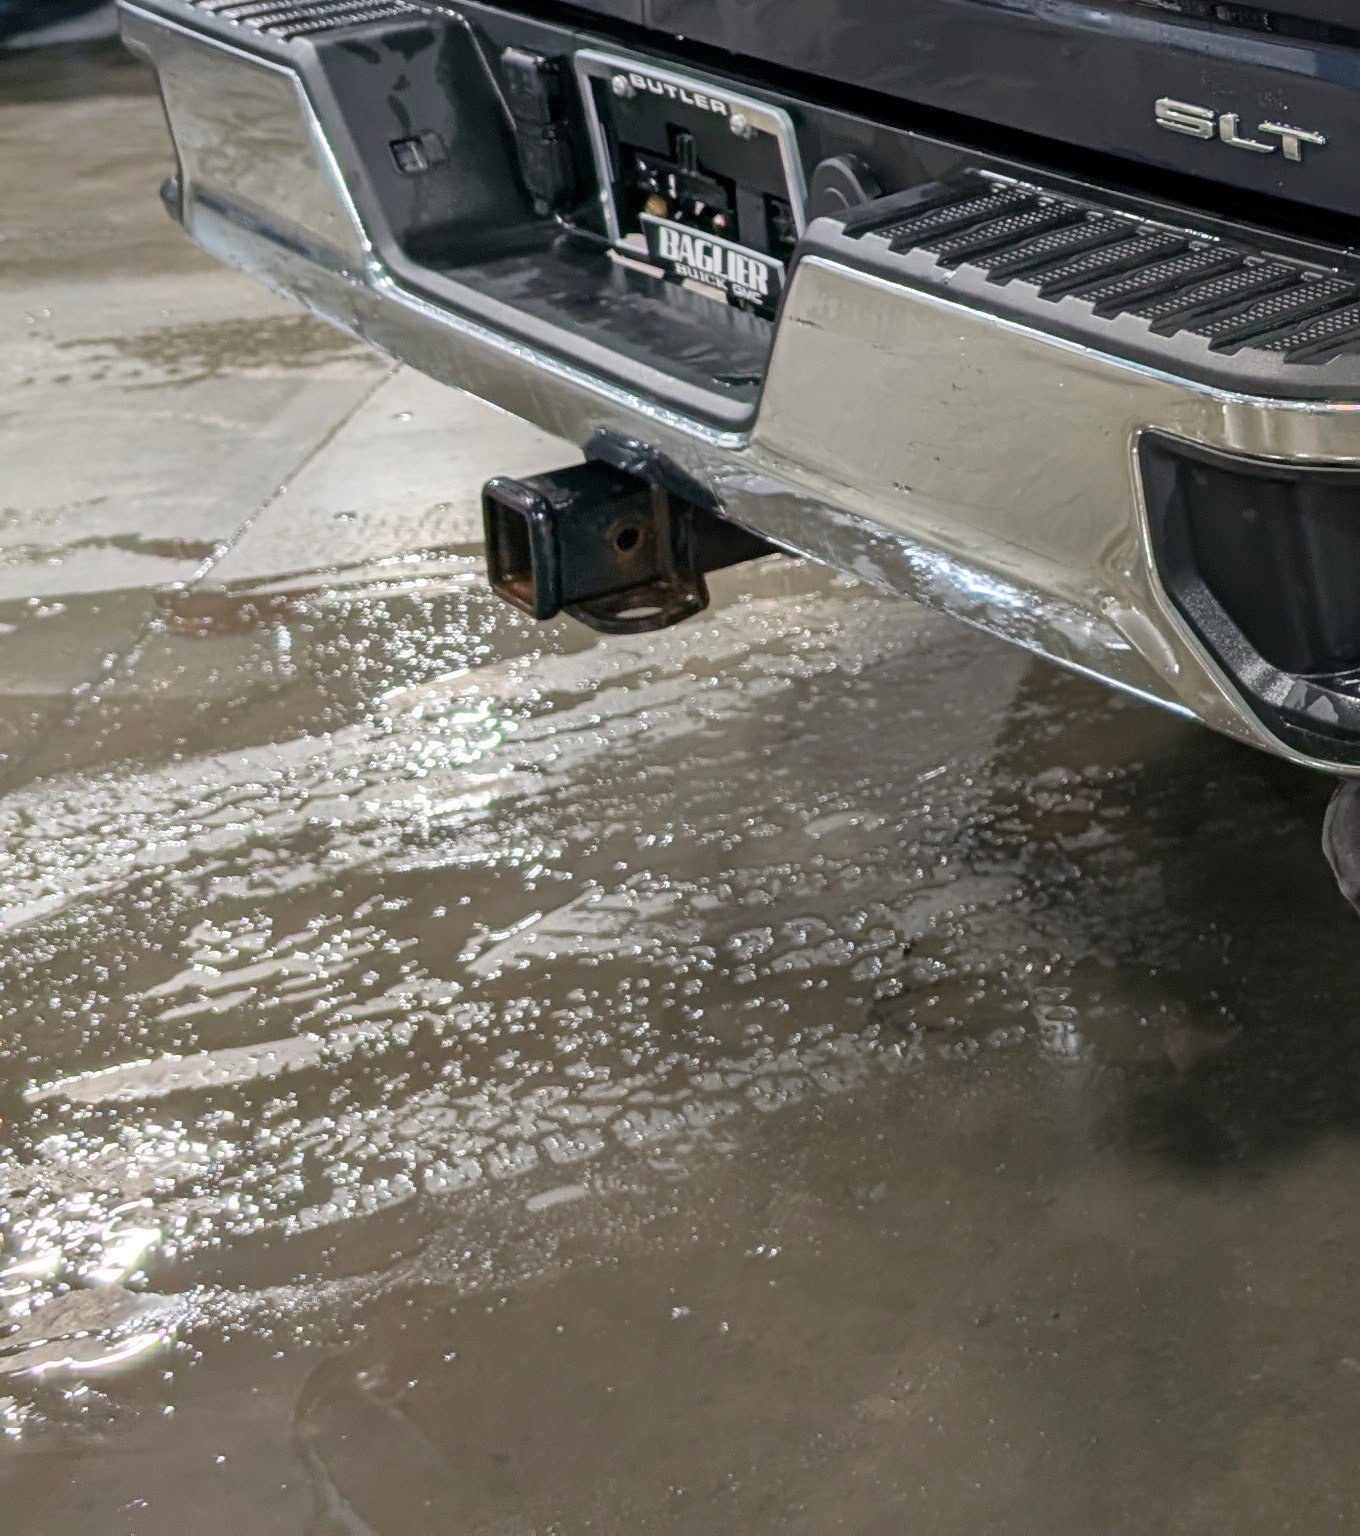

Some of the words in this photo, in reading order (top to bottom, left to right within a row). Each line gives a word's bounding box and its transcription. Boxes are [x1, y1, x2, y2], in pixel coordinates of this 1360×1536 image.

[629, 73, 728, 116] BUTLER
[1155, 97, 1326, 162] SLT
[660, 225, 769, 296] BAGLIER
[674, 261, 729, 292] BUICK
